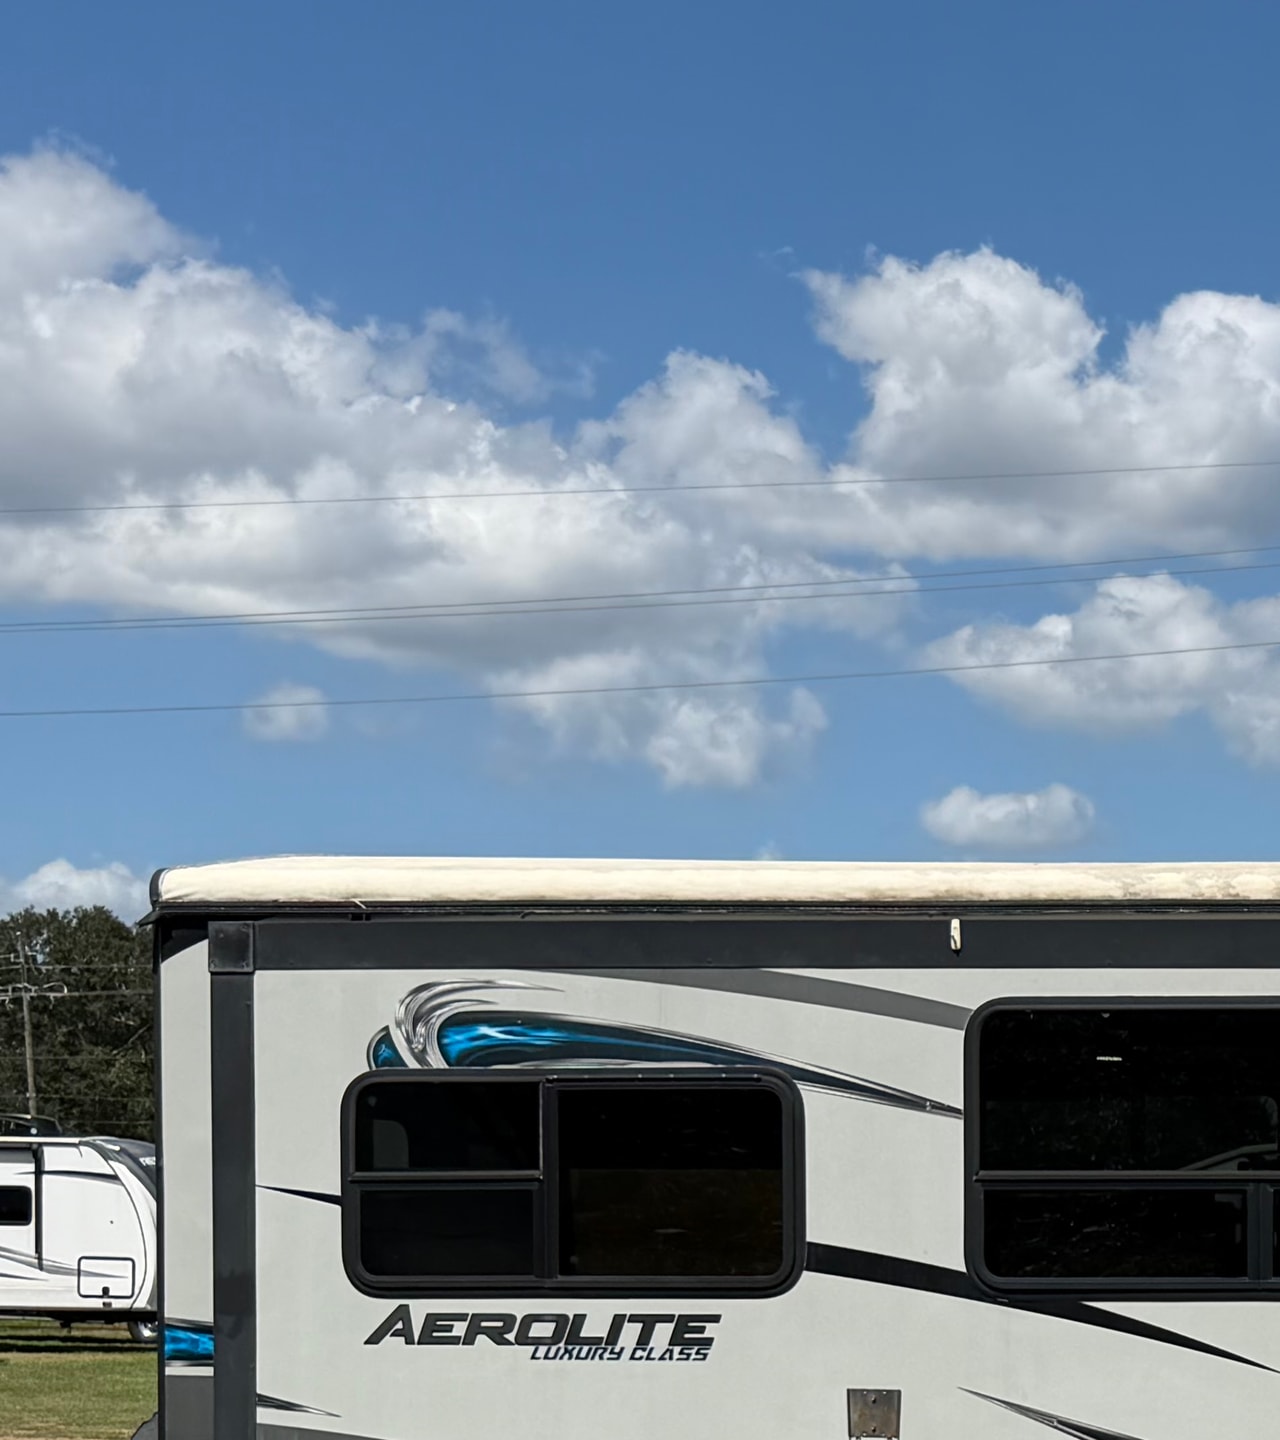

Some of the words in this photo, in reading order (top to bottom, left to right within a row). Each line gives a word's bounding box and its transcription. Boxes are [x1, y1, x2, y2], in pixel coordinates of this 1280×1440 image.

[363, 1303, 722, 1346] AEROLITE
[530, 1346, 624, 1361] LUXURY
[628, 1346, 711, 1361] CLASS
